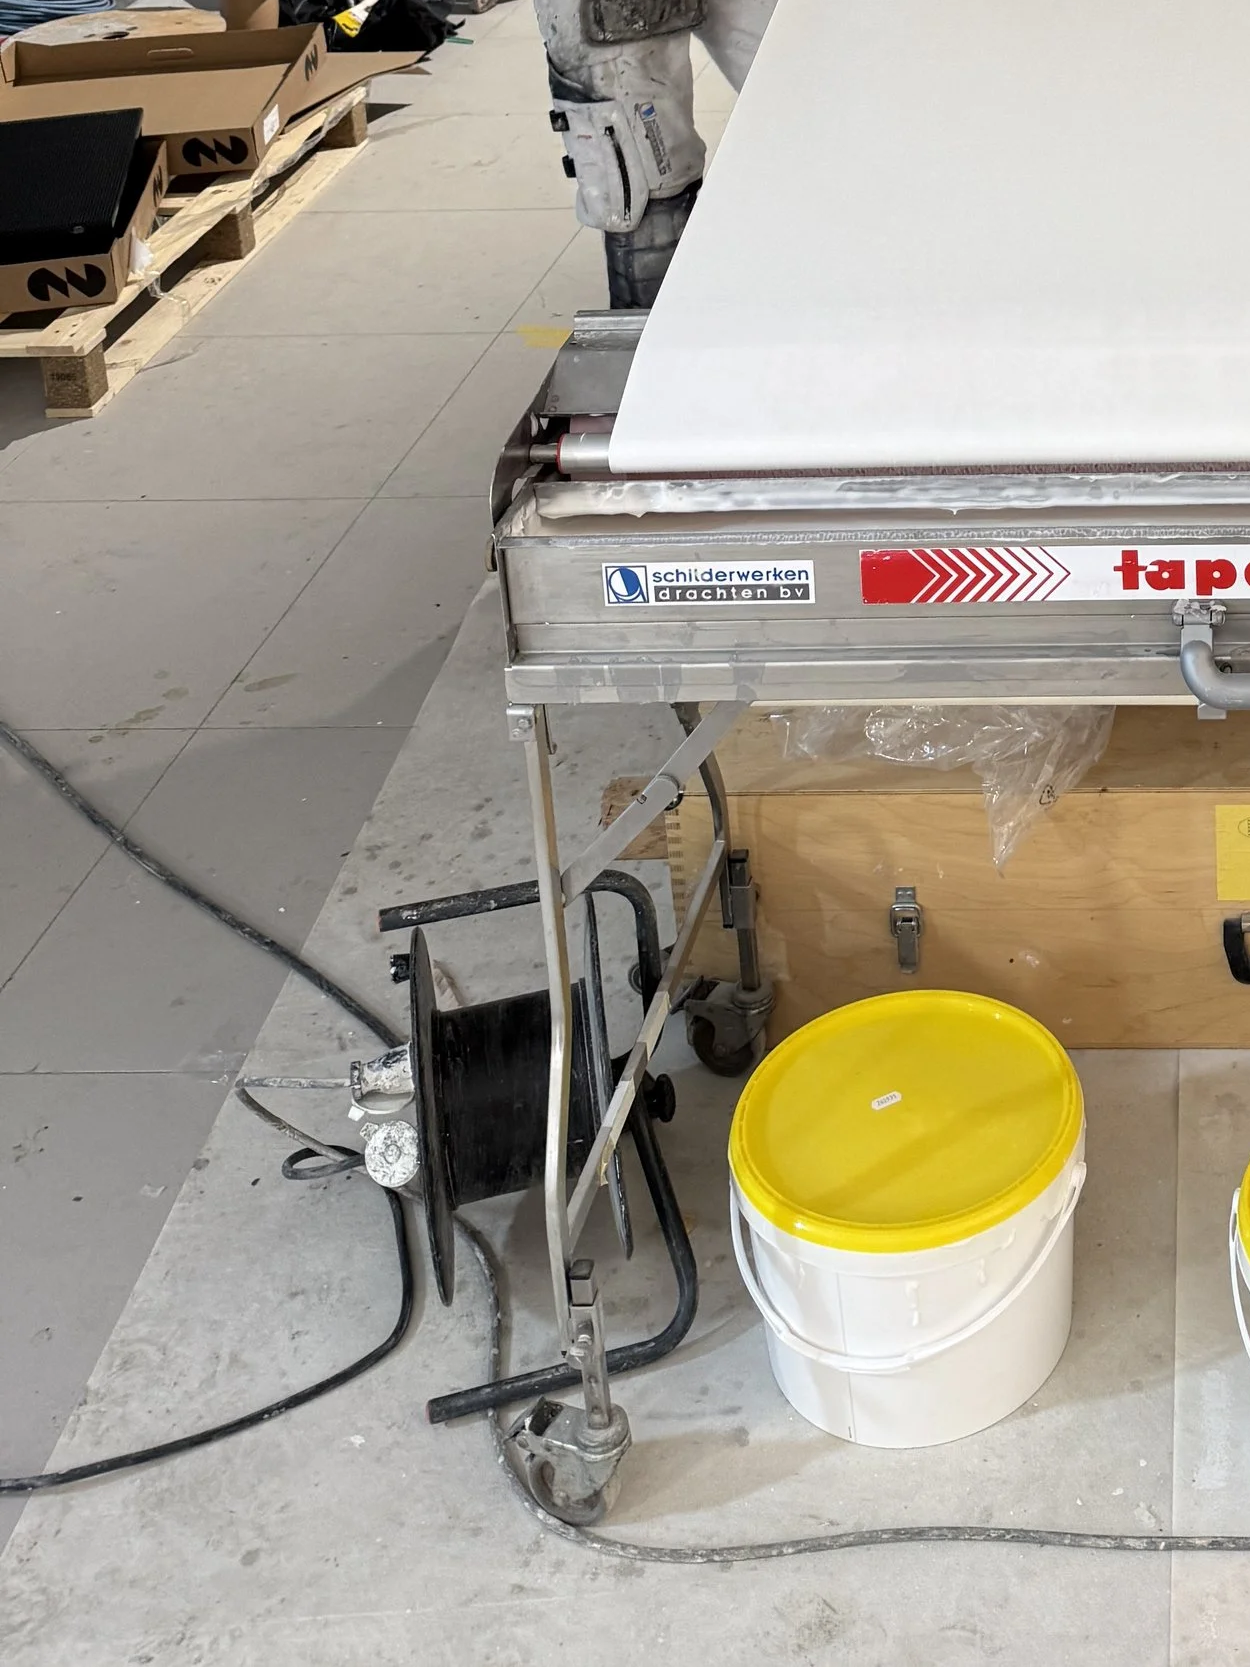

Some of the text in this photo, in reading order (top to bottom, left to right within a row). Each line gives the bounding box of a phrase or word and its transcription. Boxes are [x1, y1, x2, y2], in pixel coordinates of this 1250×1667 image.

[651, 566, 810, 583] schilderwerken
[658, 585, 804, 601] drachten bv
